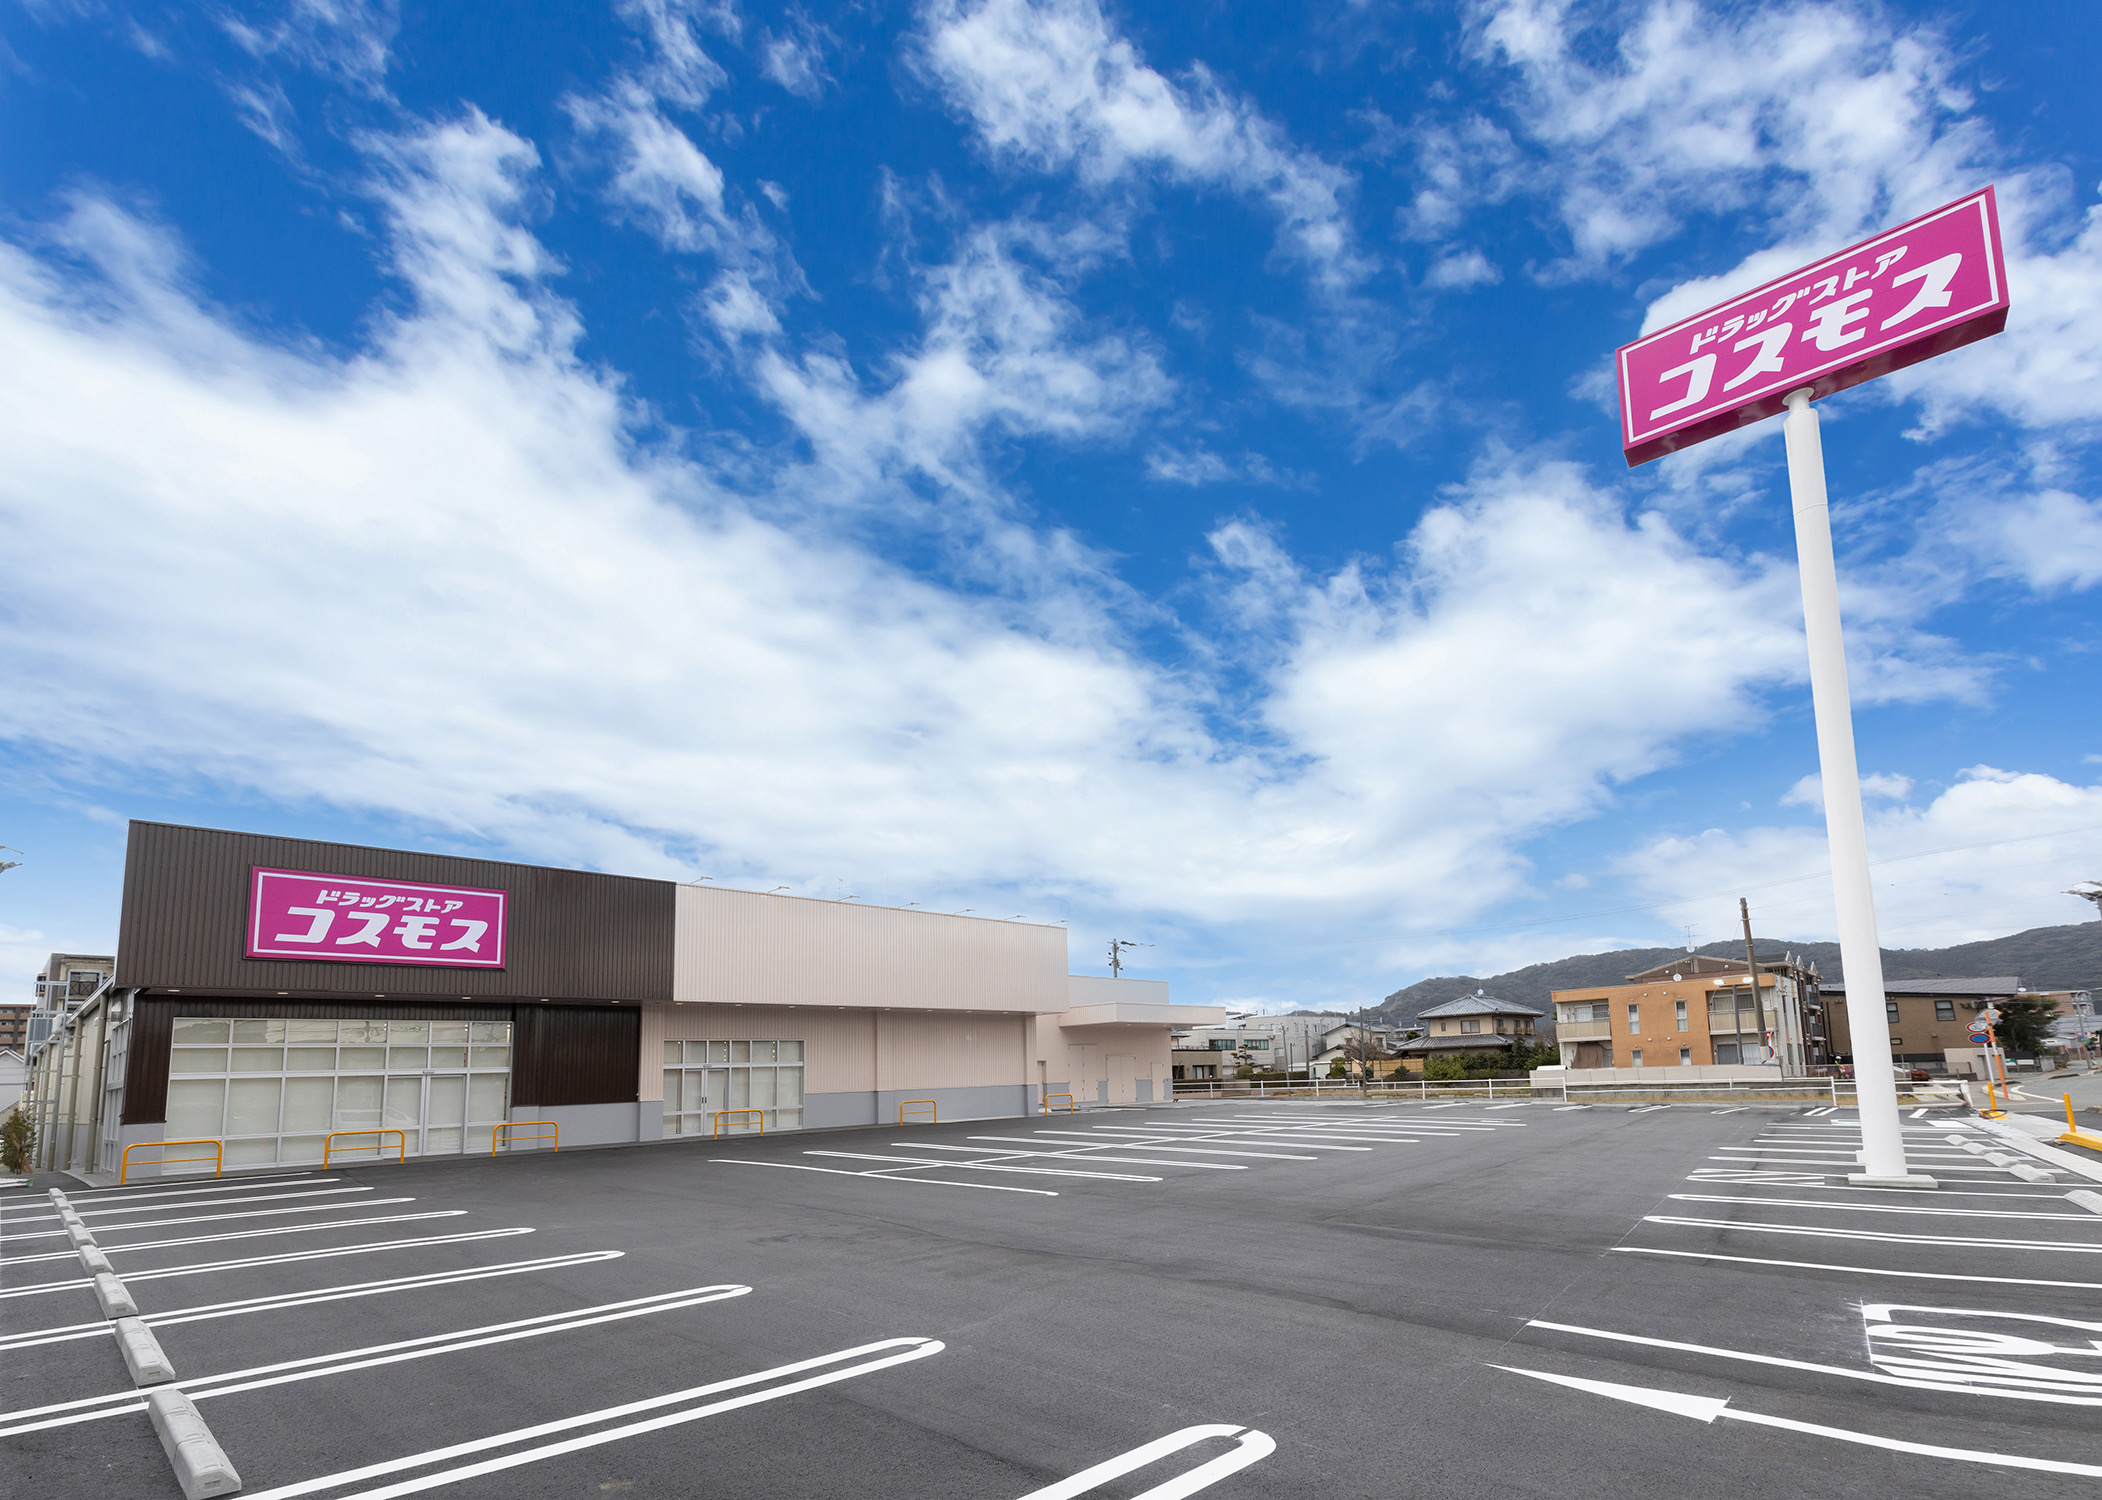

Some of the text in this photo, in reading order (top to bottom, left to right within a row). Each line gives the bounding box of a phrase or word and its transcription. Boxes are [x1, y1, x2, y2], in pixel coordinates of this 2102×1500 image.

[1649, 252, 1963, 421] コスモス
[1690, 245, 1908, 356] ドラッグストア
[274, 906, 489, 954] コスモス
[316, 889, 464, 914] ドラッグストア
